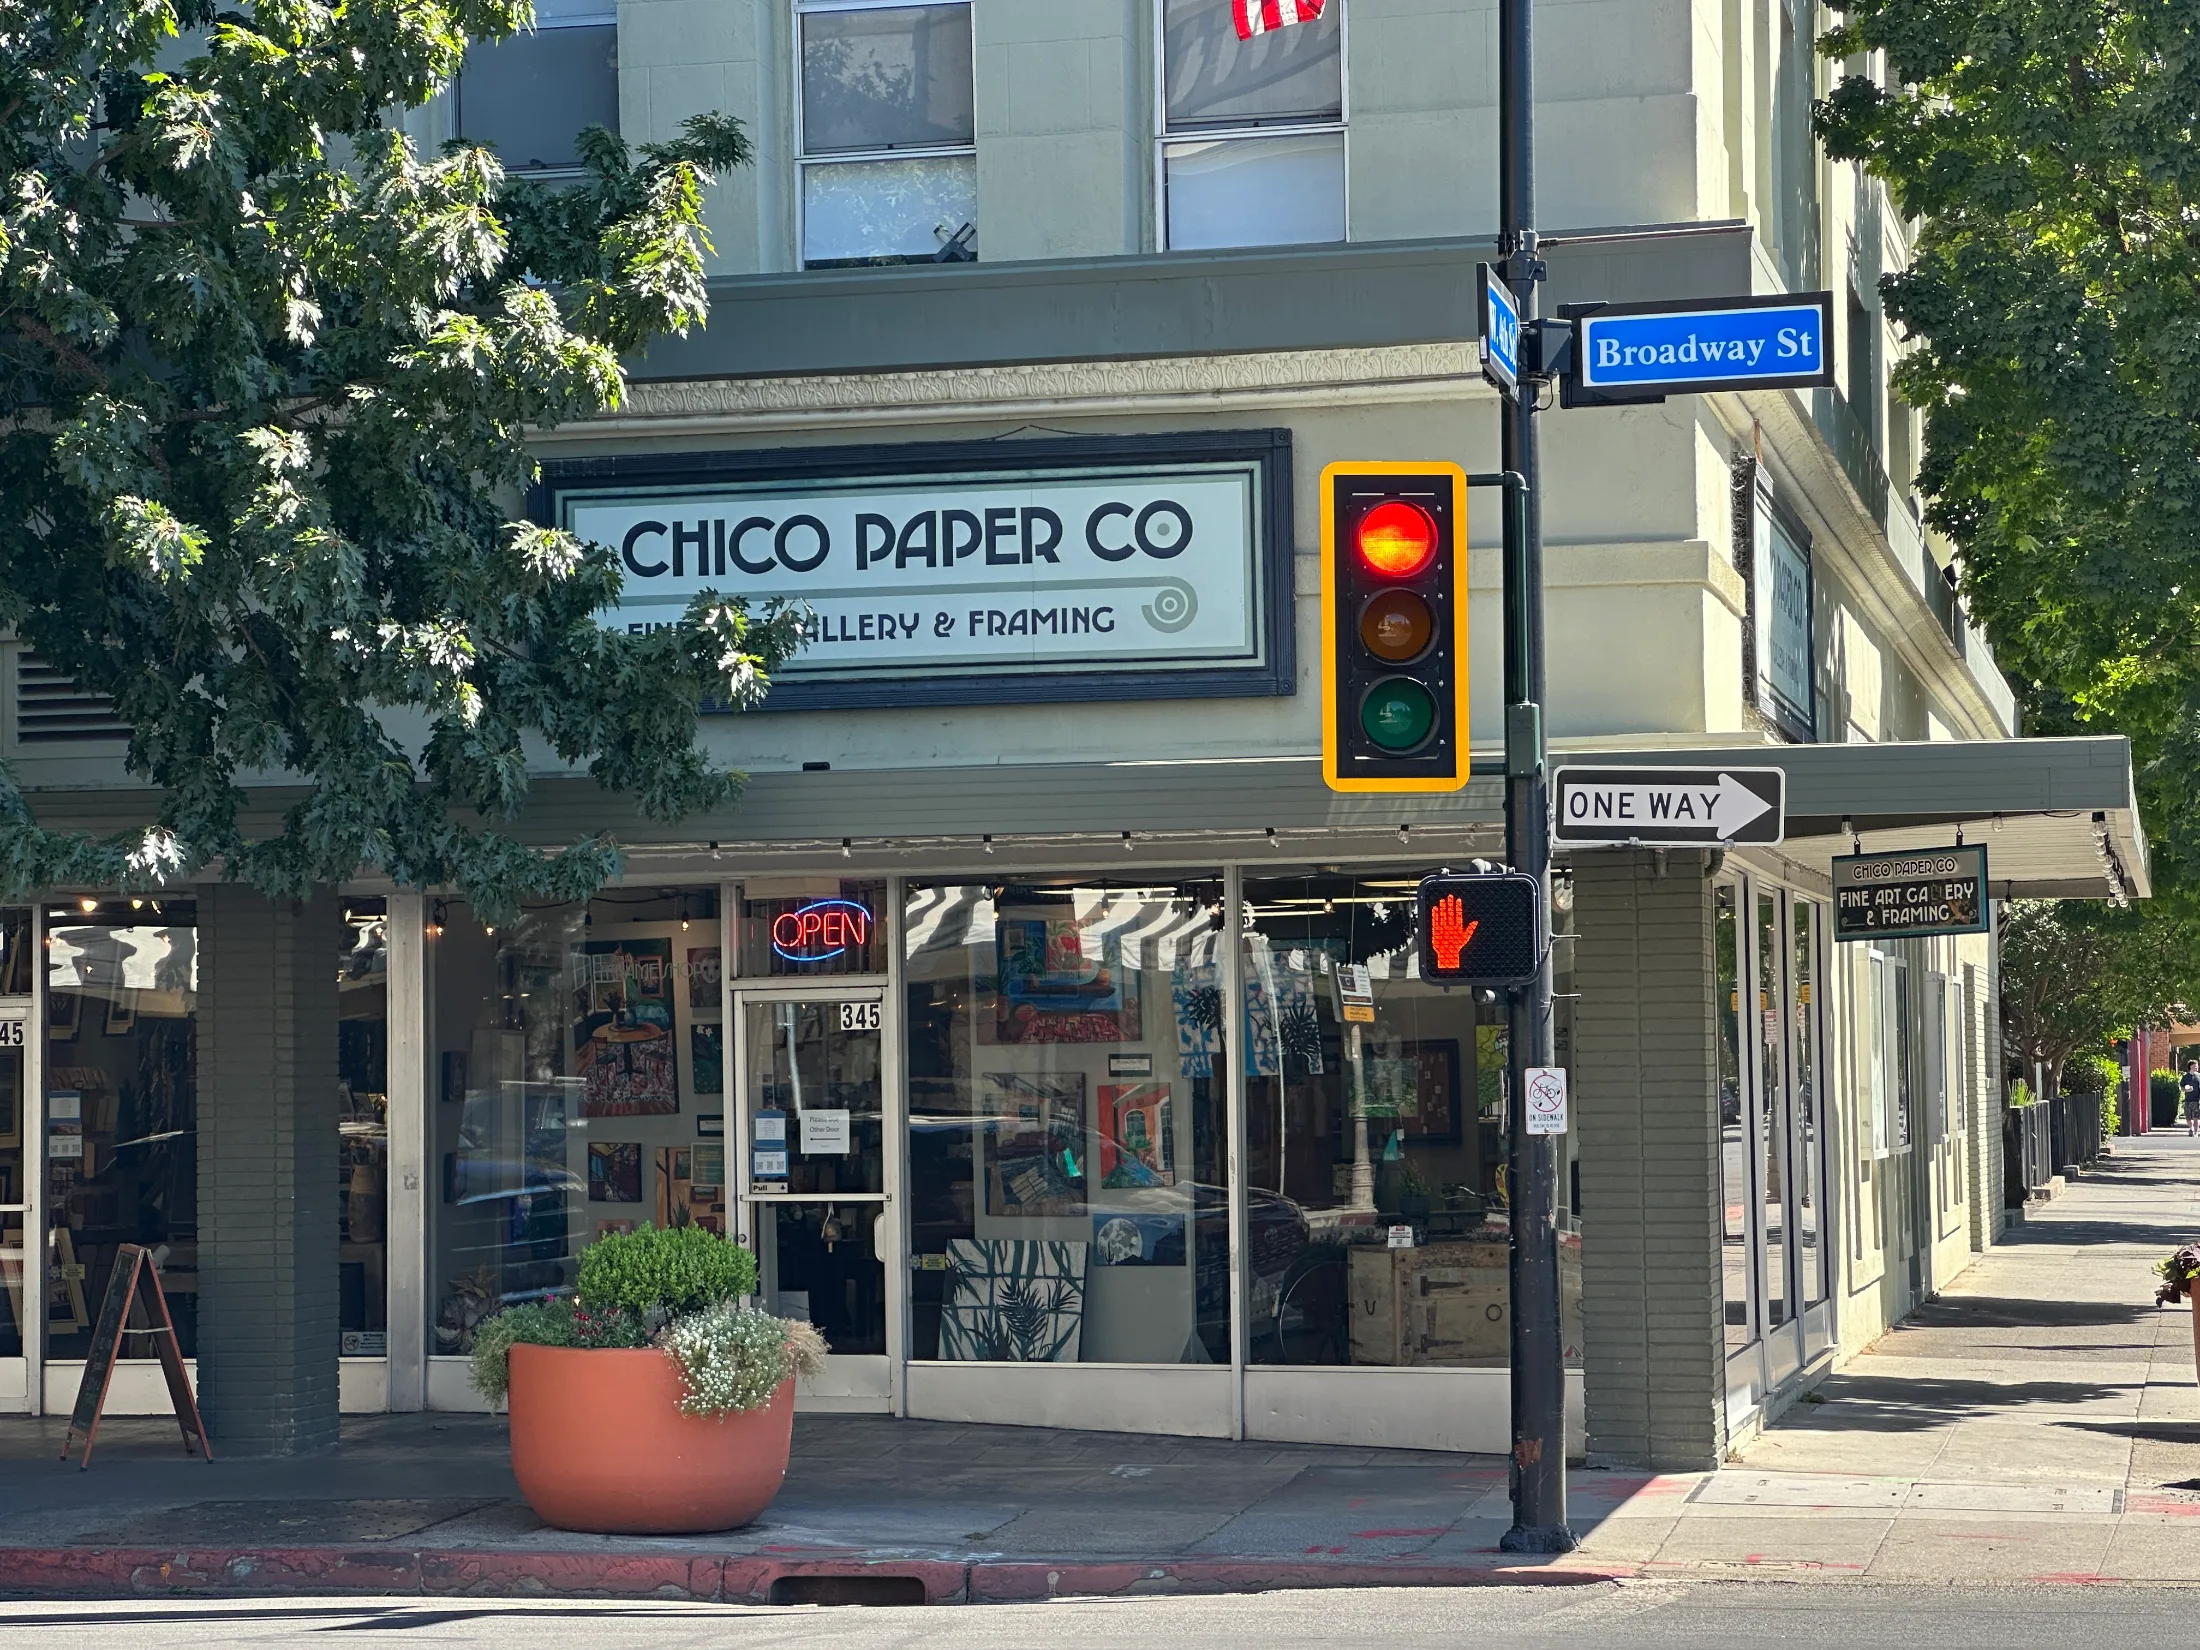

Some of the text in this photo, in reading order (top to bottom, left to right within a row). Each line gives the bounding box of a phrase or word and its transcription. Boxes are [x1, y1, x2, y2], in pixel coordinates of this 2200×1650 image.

[1596, 327, 1813, 369] Broadway St
[621, 499, 1194, 578] CHICO PAPER CO
[786, 613, 920, 644] ALLERY
[933, 611, 956, 638] &
[969, 606, 1116, 637] FRAMING
[1569, 791, 1721, 820] ONE WAY
[1853, 856, 1956, 880] CHICO PAPER CO
[1839, 881, 1974, 908] FINE ART GAERY
[1866, 904, 1950, 926] & FRAMING
[773, 912, 865, 947] OPEN
[662, 962, 703, 980] SHOP
[842, 1003, 880, 1029] 345
[1529, 1114, 1563, 1122] ON SIDEWALK
